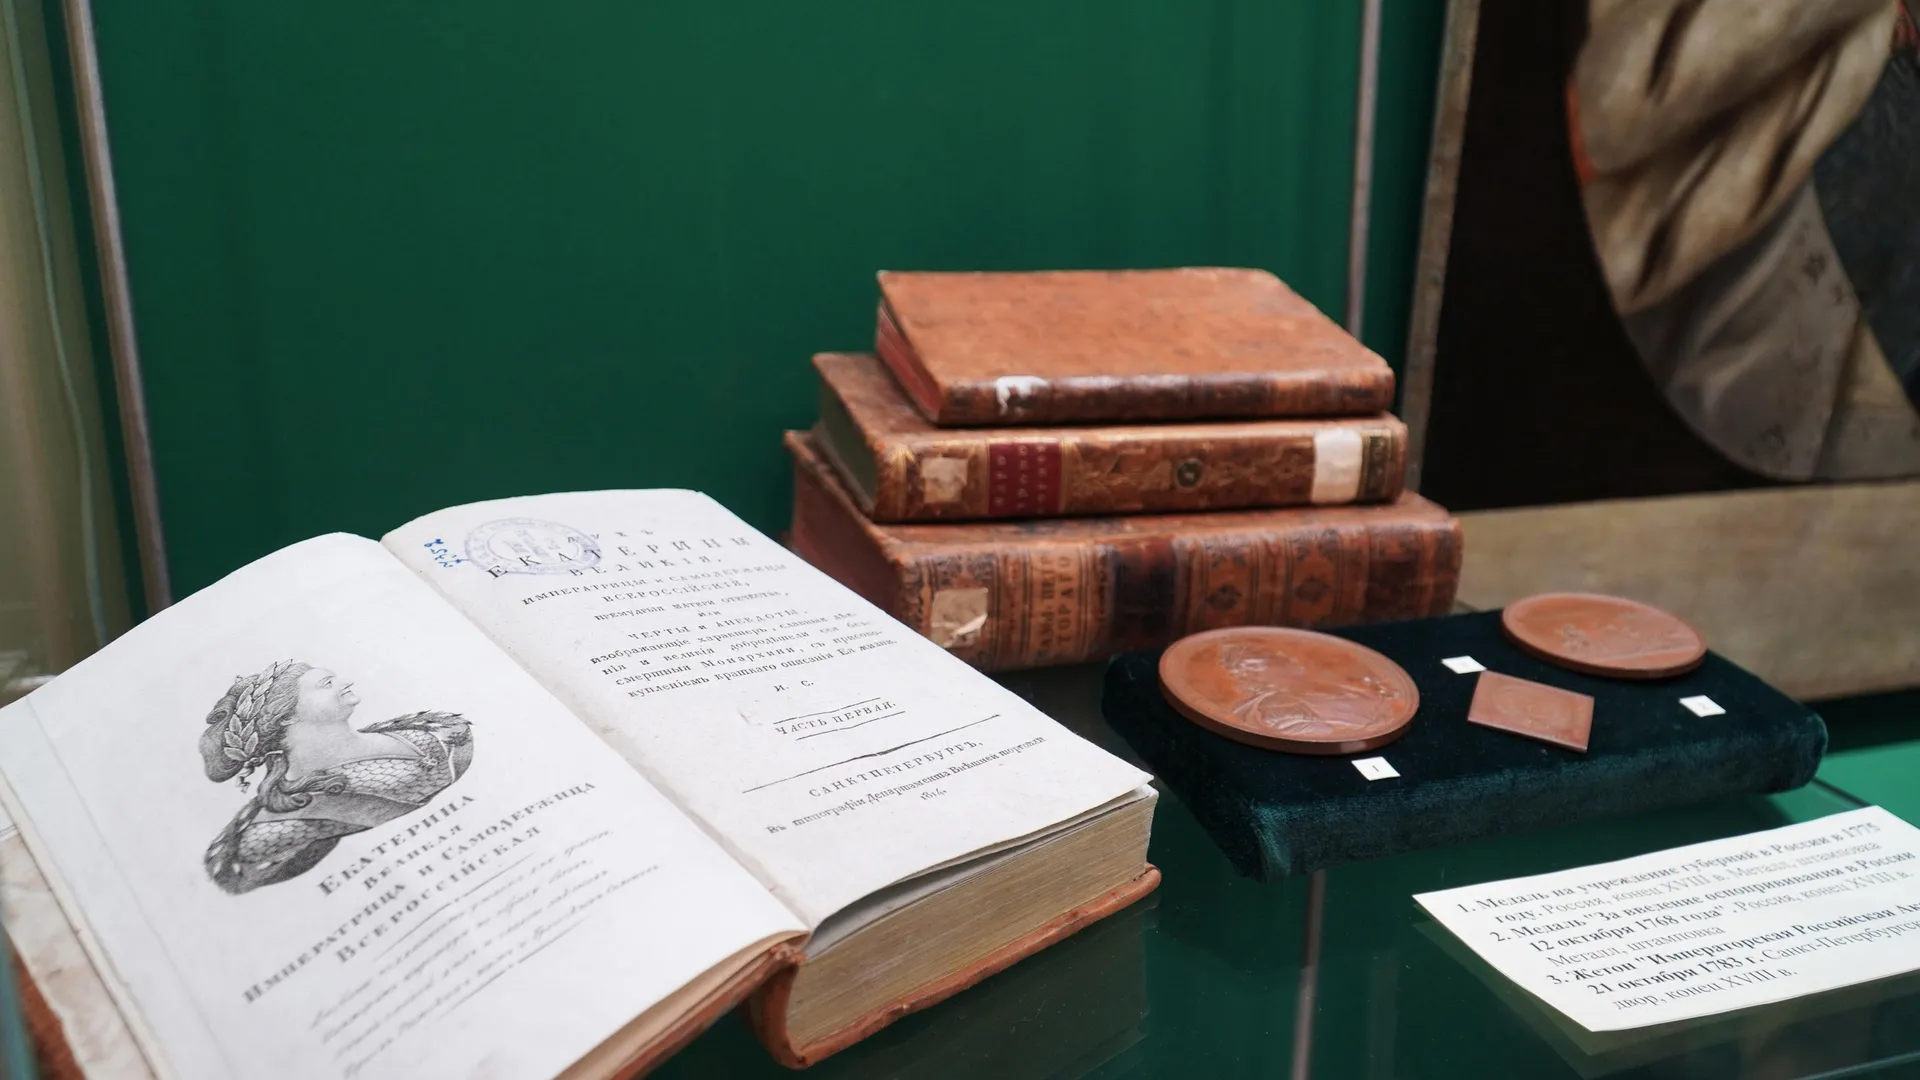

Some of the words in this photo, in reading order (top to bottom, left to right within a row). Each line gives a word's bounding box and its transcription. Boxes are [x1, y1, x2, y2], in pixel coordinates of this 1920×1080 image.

[486, 537, 749, 580] ЕКАТЕРИНЫ
[522, 580, 647, 605] ИМПЕРАТРИЦЫ
[672, 600, 716, 611] МАТЕРИ
[628, 626, 691, 640] ЧЕРТЫ
[775, 718, 827, 735] ЧАСТЬ
[833, 702, 896, 723] ПЕРВАЯ.
[316, 795, 475, 896] ЕКАТЕРИНА
[362, 824, 463, 891] ВЕЛИКАЯ
[1457, 904, 1476, 913] 1.
[1476, 893, 1550, 910] Медаль
[1551, 888, 1576, 898] на
[1576, 868, 1679, 894] учреждение
[1681, 852, 1758, 872] губерний
[1759, 849, 1771, 857] в
[1771, 837, 1831, 854] России
[1845, 823, 1880, 838] 1775
[242, 882, 406, 1003] ИМПЕРАТРИЦА
[442, 782, 595, 860] САМОДЕРЖИЦА
[1490, 932, 1514, 942] 2.
[1510, 920, 1587, 938] Медаль
[1583, 912, 1622, 921] "За
[1623, 896, 1704, 916] введение
[1705, 868, 1844, 900] оспопрививания
[1845, 862, 1858, 871] в
[1858, 852, 1916, 869] России
[1494, 910, 1543, 923] году.
[1541, 898, 1612, 914] Россия,
[1612, 886, 1664, 902] конец
[1661, 875, 1711, 892] XVIII
[1713, 872, 1730, 881] в.
[1730, 862, 1795, 878] Металл,
[1797, 843, 1881, 865] штамповка
[1529, 940, 1556, 952] 12
[1557, 925, 1636, 947] октября
[1635, 915, 1679, 930] 1768
[1736, 892, 1802, 911] Россия,
[1803, 880, 1846, 898] конец
[1845, 872, 1899, 890] XVIII
[1899, 871, 1914, 879] в.
[1546, 975, 1570, 985] 3.
[1566, 960, 1638, 981] Жетон
[1635, 926, 1794, 967] "Императорская
[1793, 909, 1897, 936] Российская
[1896, 903, 1920, 914] Ак
[1546, 947, 1628, 968] Металл,
[1626, 927, 1726, 952] штамповка
[1587, 983, 1615, 994] 21
[1617, 968, 1699, 991] октября
[1698, 956, 1744, 973] 1783
[1746, 956, 1765, 964] г.
[1612, 995, 1667, 1010] двор,
[1665, 979, 1726, 1000] конец
[1724, 968, 1778, 988] XVIII
[1777, 969, 1798, 977] в.
